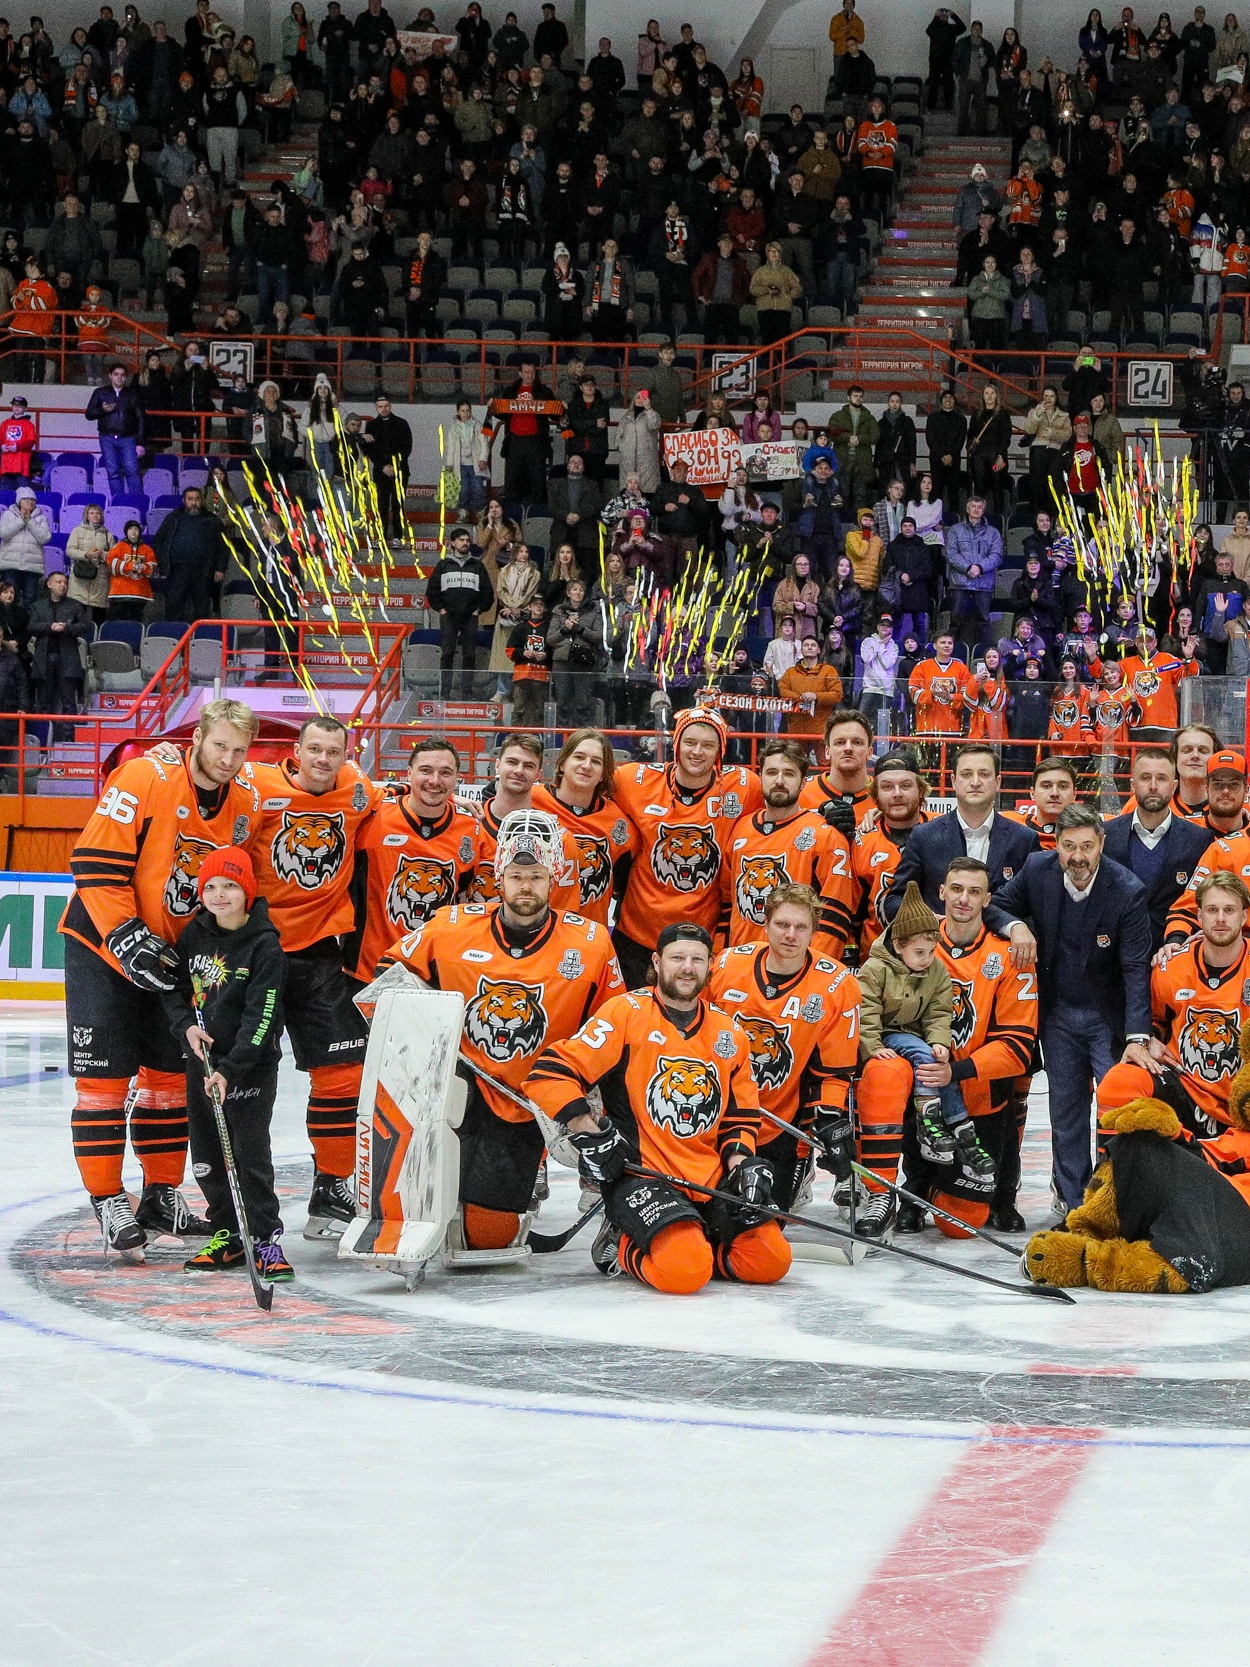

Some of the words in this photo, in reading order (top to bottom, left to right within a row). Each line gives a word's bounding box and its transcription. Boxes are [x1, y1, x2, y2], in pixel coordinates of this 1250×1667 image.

[877, 319, 914, 327] ТЕРРИТОРИЯ
[915, 319, 937, 327] ТИГРОВ
[718, 361, 750, 392] 23
[862, 361, 899, 370] ТЕРРИТОРИЯ
[901, 361, 924, 370] ТИГРОВ
[1134, 368, 1167, 399] 24
[665, 430, 719, 453] СПАСИБО
[722, 428, 739, 446] ЗА
[667, 448, 719, 468] СЕЗОН
[719, 694, 753, 709] СЕЗОН
[756, 697, 792, 712] ОХОТЫ
[97, 785, 140, 825] 96
[112, 927, 152, 960] CCM
[189, 954, 223, 980] CRASH!
[263, 988, 277, 1018] TURTLE
[781, 996, 801, 1020] A
[251, 1018, 272, 1046] POWER
[73, 1051, 93, 1059] ЦЕНТР
[73, 1059, 109, 1068] АМУРСКИЙ
[73, 1066, 88, 1074] ТИГР
[638, 1201, 661, 1218] ЦЕНТР
[641, 1200, 679, 1222] АМУРСКИЙ
[645, 1213, 662, 1227] ТИГР
